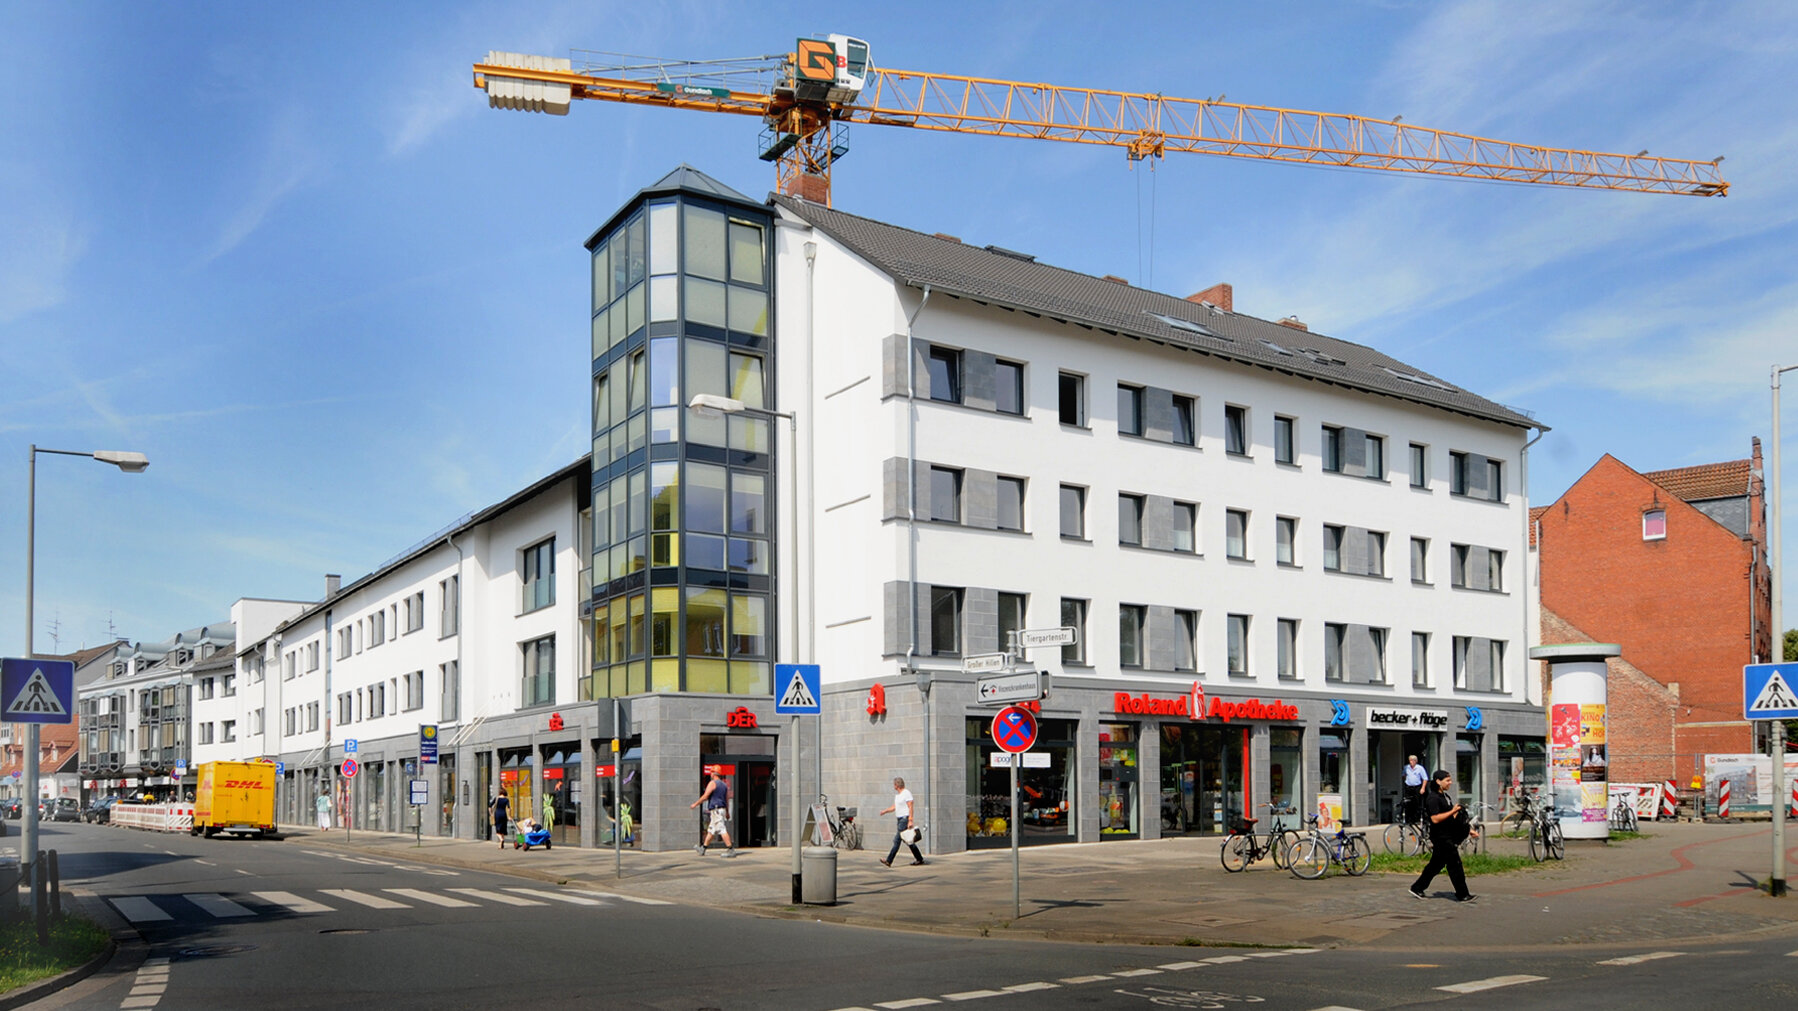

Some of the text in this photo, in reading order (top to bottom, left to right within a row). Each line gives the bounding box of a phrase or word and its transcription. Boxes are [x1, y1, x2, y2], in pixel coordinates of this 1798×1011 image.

[1026, 633, 1069, 644] Tiergartenstr.
[1114, 692, 1299, 723] Roland Apotheke
[727, 708, 759, 728] DER
[1370, 709, 1412, 724] becker
[1419, 711, 1448, 728] flöge
[1581, 713, 1600, 722] KINO
[224, 780, 264, 790] DHL
